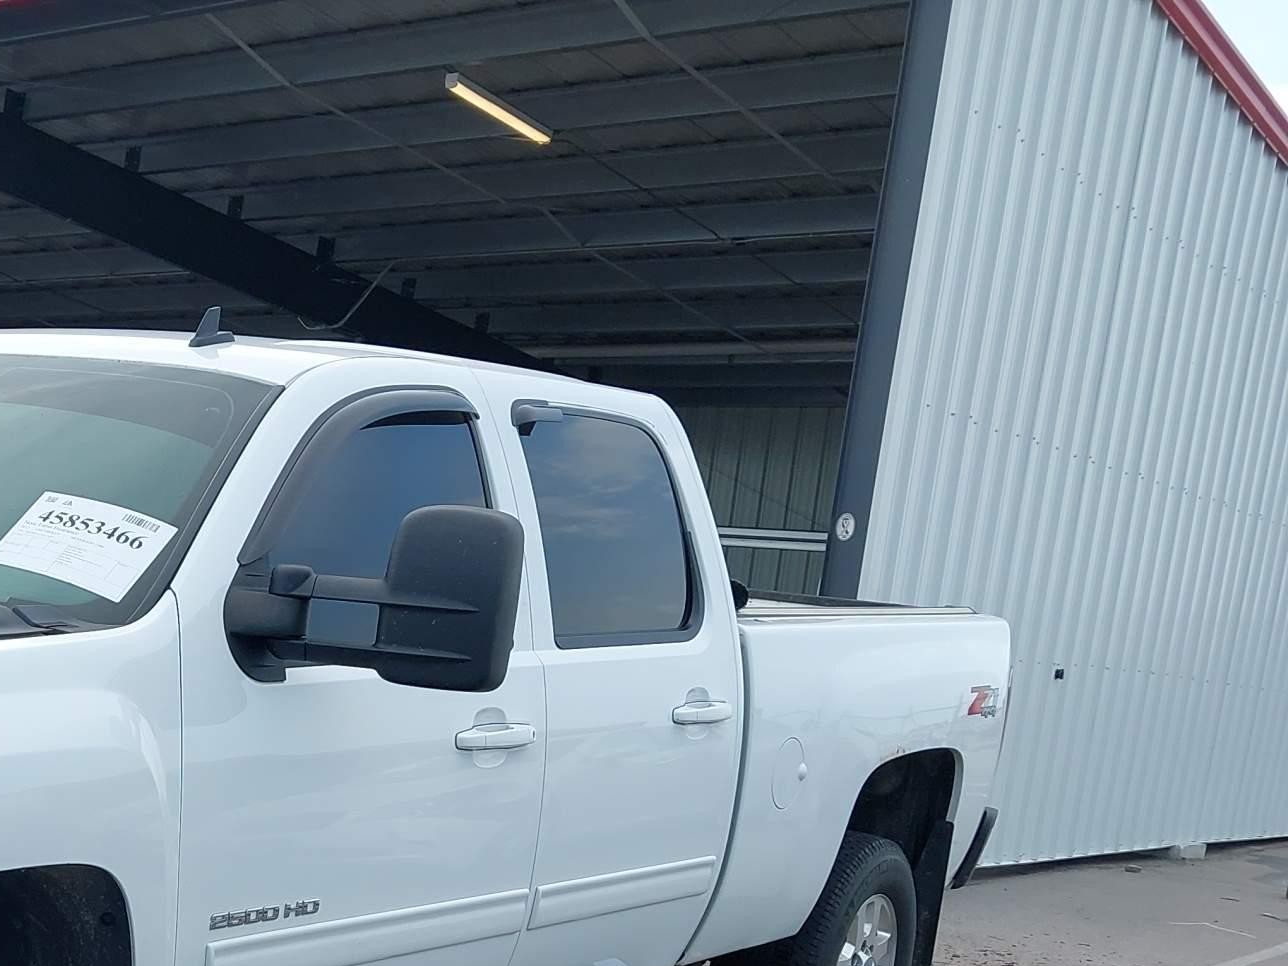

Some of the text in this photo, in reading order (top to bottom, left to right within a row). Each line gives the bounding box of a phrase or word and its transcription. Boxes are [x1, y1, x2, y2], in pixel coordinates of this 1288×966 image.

[37, 509, 152, 550] 45853466
[208, 898, 321, 931] 2500 HD
